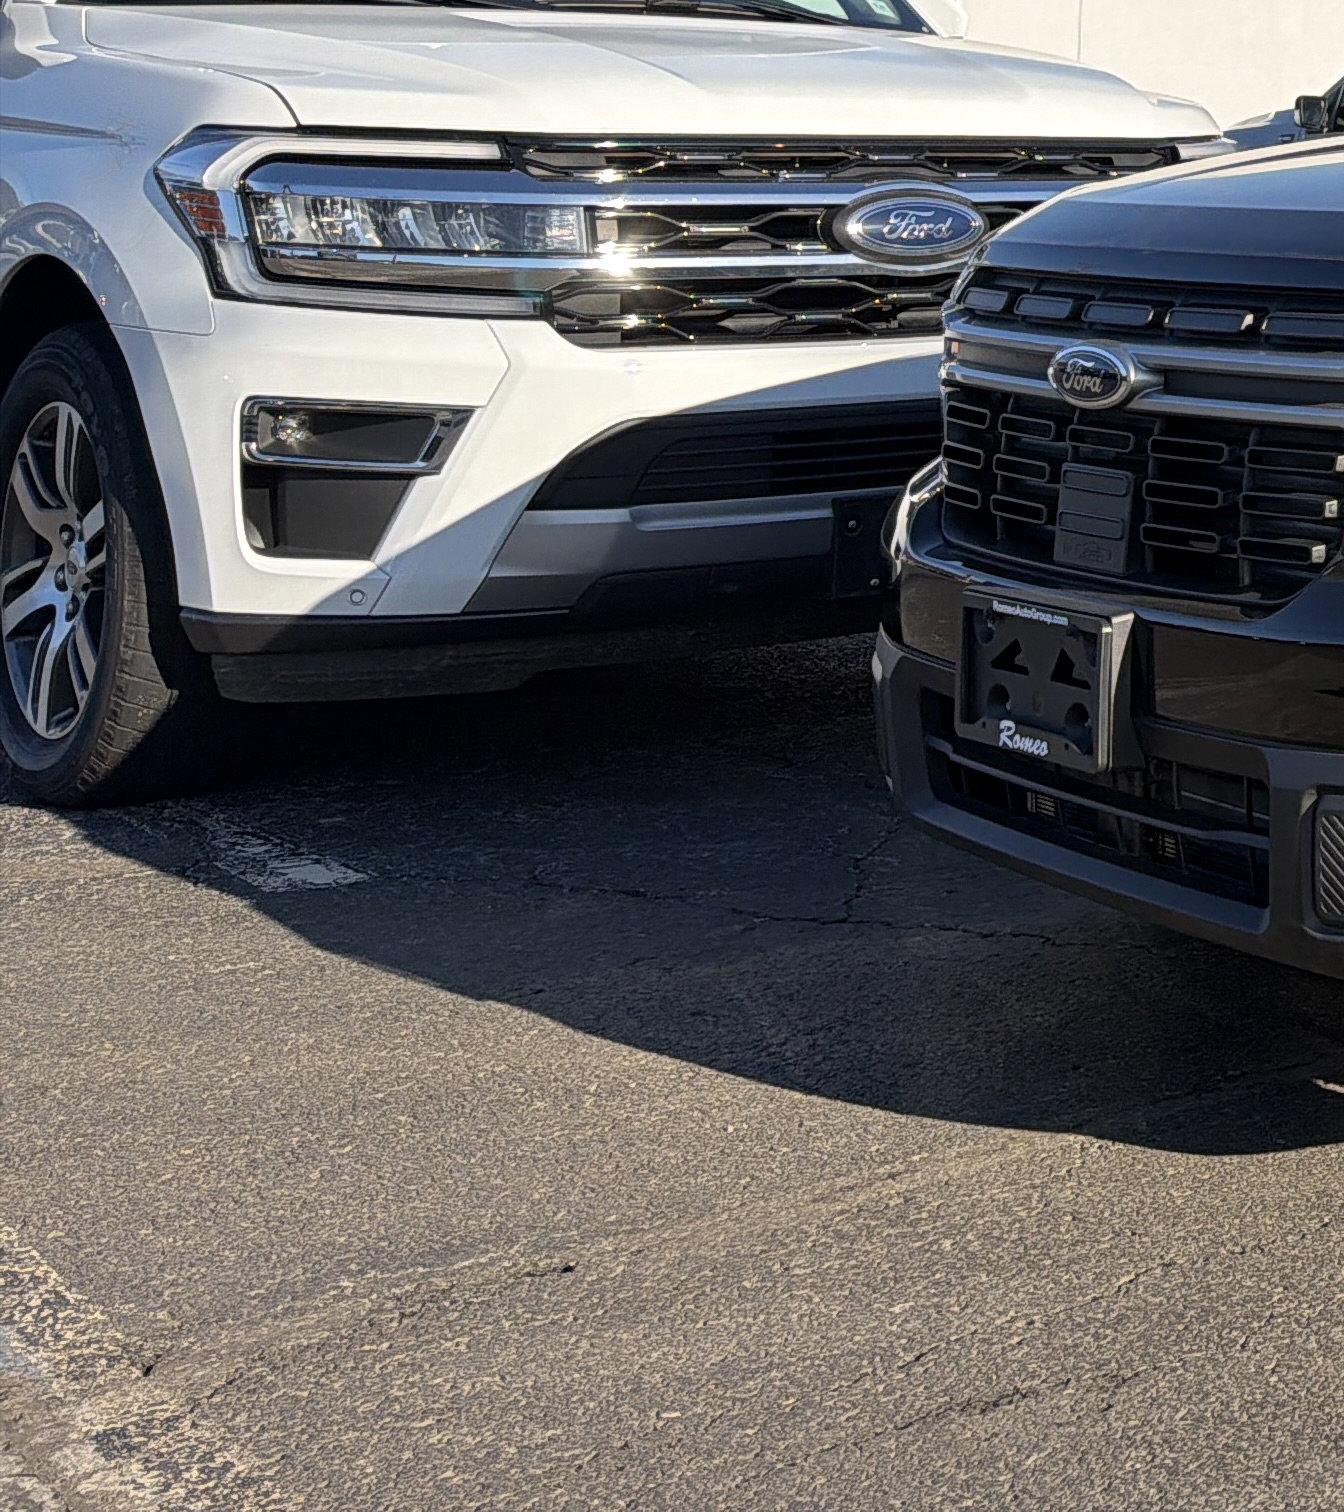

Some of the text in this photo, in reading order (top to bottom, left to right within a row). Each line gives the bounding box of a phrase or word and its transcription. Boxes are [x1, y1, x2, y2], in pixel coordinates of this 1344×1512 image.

[882, 209, 953, 240] Ford
[1062, 357, 1104, 394] Ford
[999, 719, 1049, 757] Romeo
